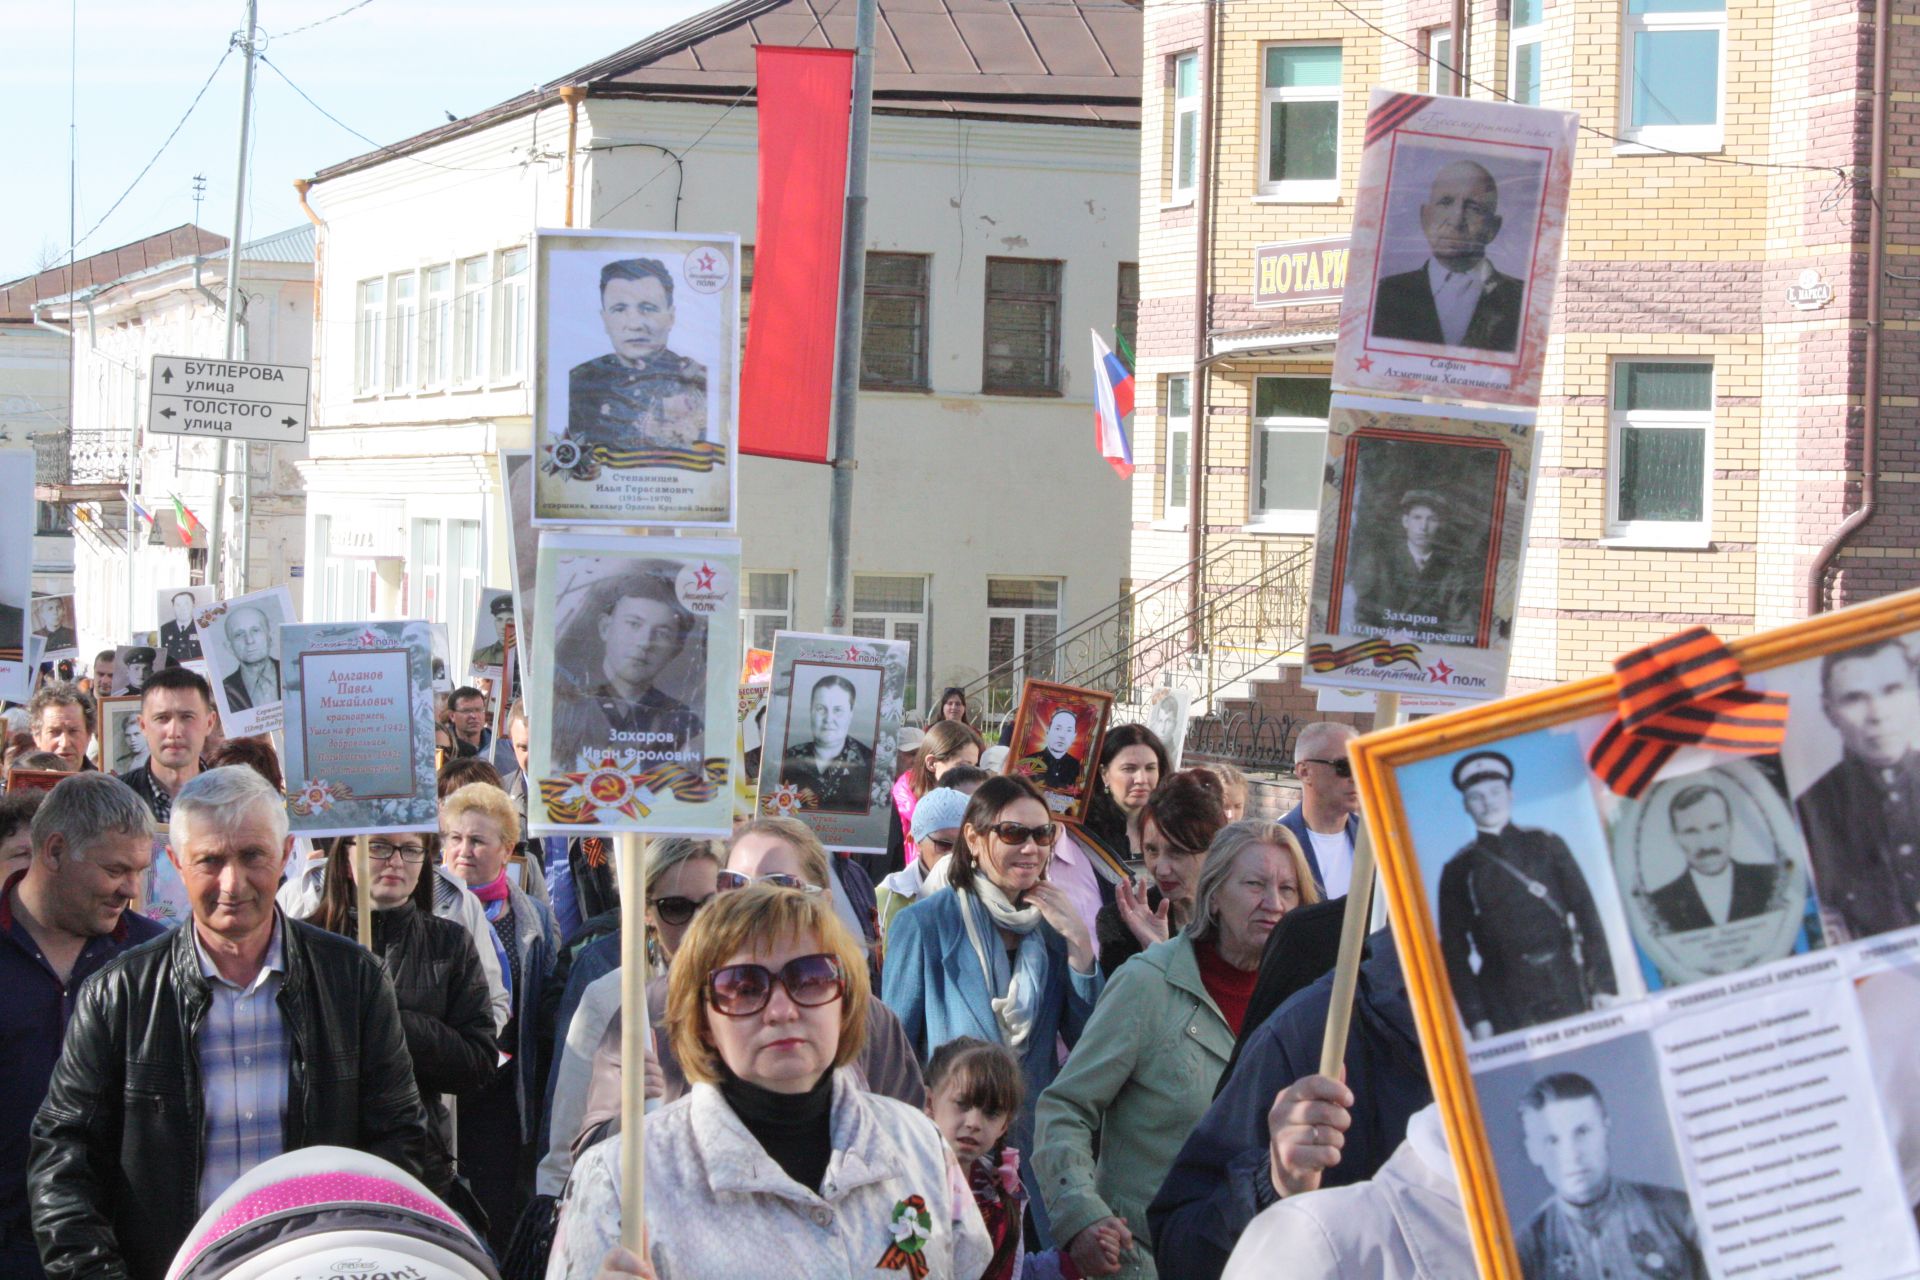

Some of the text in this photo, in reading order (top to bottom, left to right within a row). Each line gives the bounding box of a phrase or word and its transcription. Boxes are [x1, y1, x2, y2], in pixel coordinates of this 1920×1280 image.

[184, 361, 284, 381] БУТЛЕРОВА
[1429, 358, 1466, 371] Сафин
[185, 380, 234, 394] улица
[184, 400, 272, 418] ТОЛСТОГО
[184, 418, 232, 432] улица
[595, 484, 695, 494] Илья Герасимович
[691, 602, 716, 611] ПОЛК
[1382, 609, 1438, 625] Захаров
[1344, 623, 1475, 644] Андрей Андреевич
[328, 670, 383, 683] Долганов
[1452, 675, 1486, 687] ПОЛК
[337, 682, 373, 694] Павел
[320, 697, 394, 708] Михайлович
[609, 729, 674, 743] Захаров
[582, 747, 700, 763] Иван Фролович
